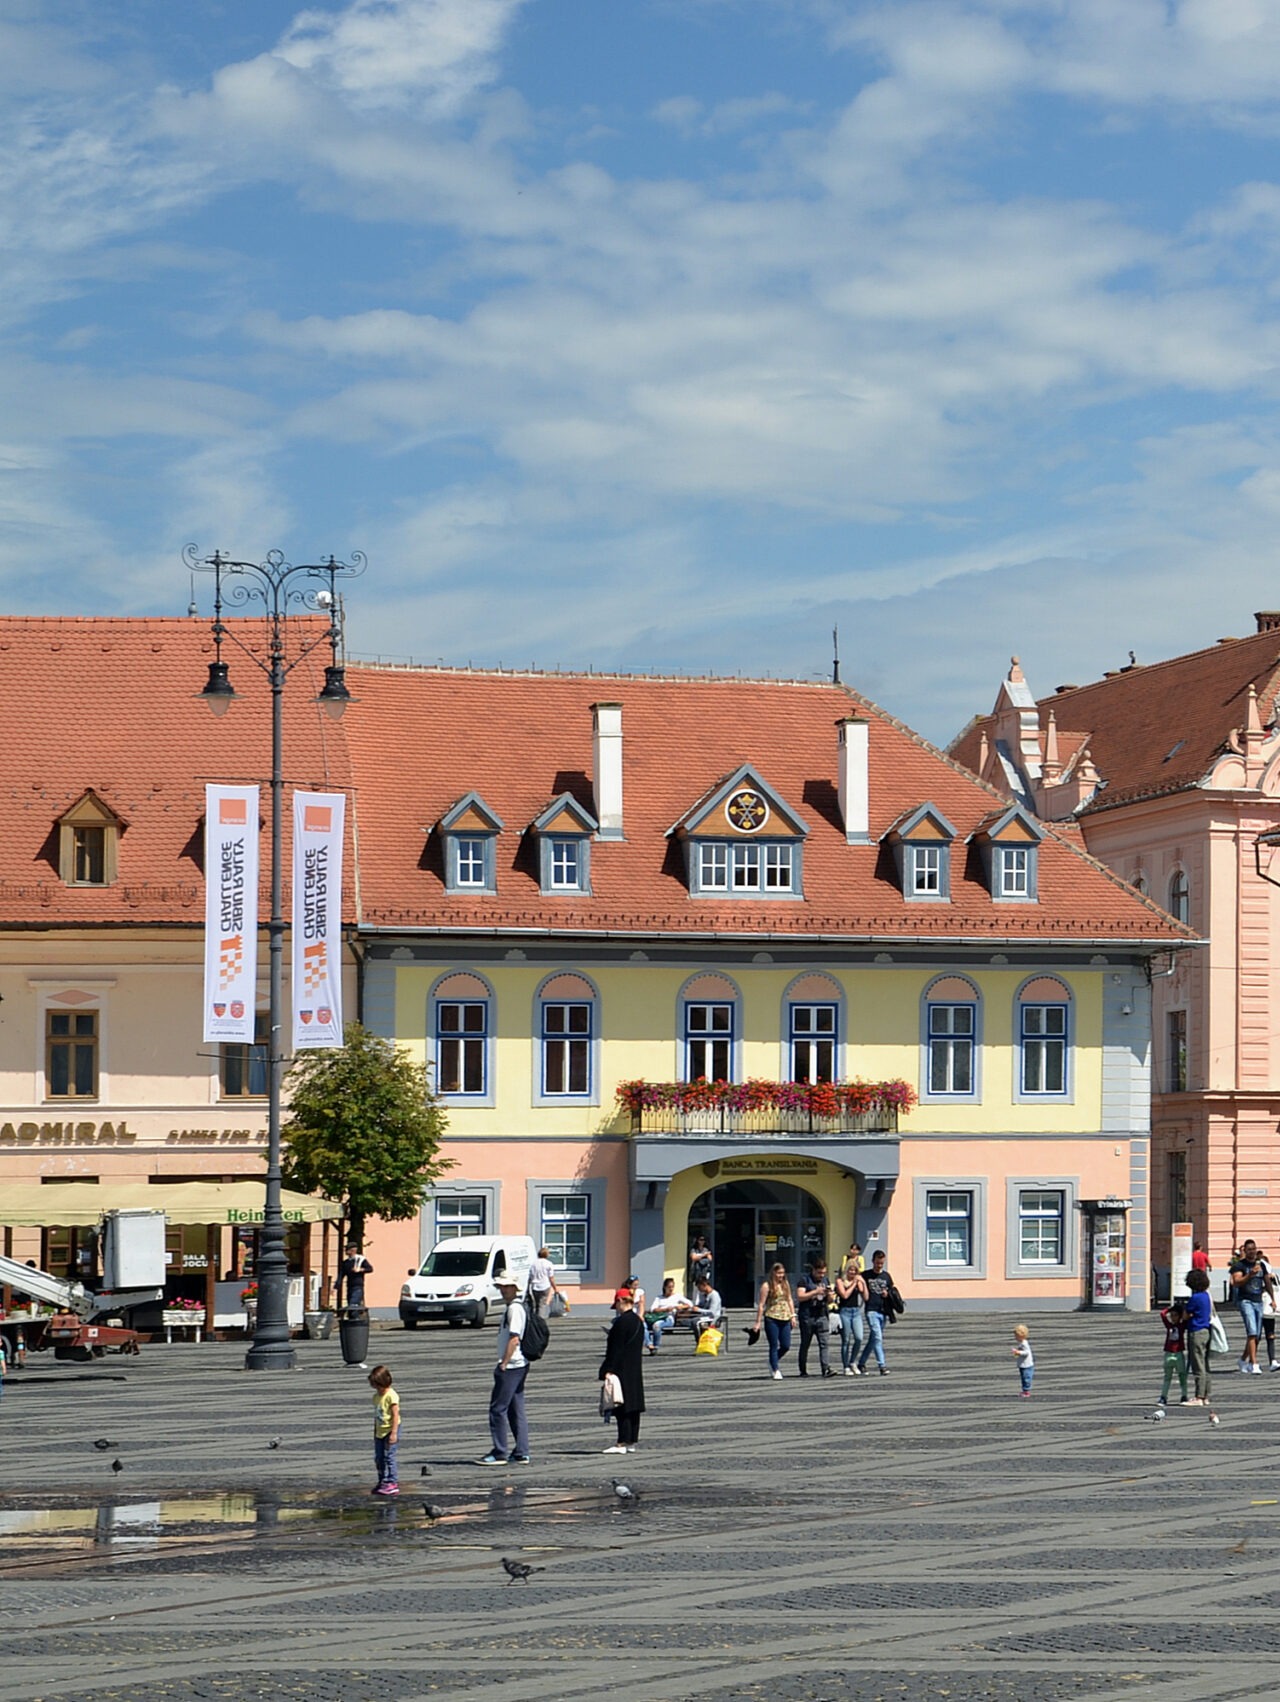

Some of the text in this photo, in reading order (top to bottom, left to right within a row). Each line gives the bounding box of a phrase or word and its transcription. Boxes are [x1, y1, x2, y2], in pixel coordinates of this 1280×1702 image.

[0, 1122, 137, 1140] ADMIRAL
[220, 1129, 251, 1139] FOR
[722, 1160, 818, 1168] BANCA TRANSILVANIA
[227, 1208, 304, 1224] Heinen
